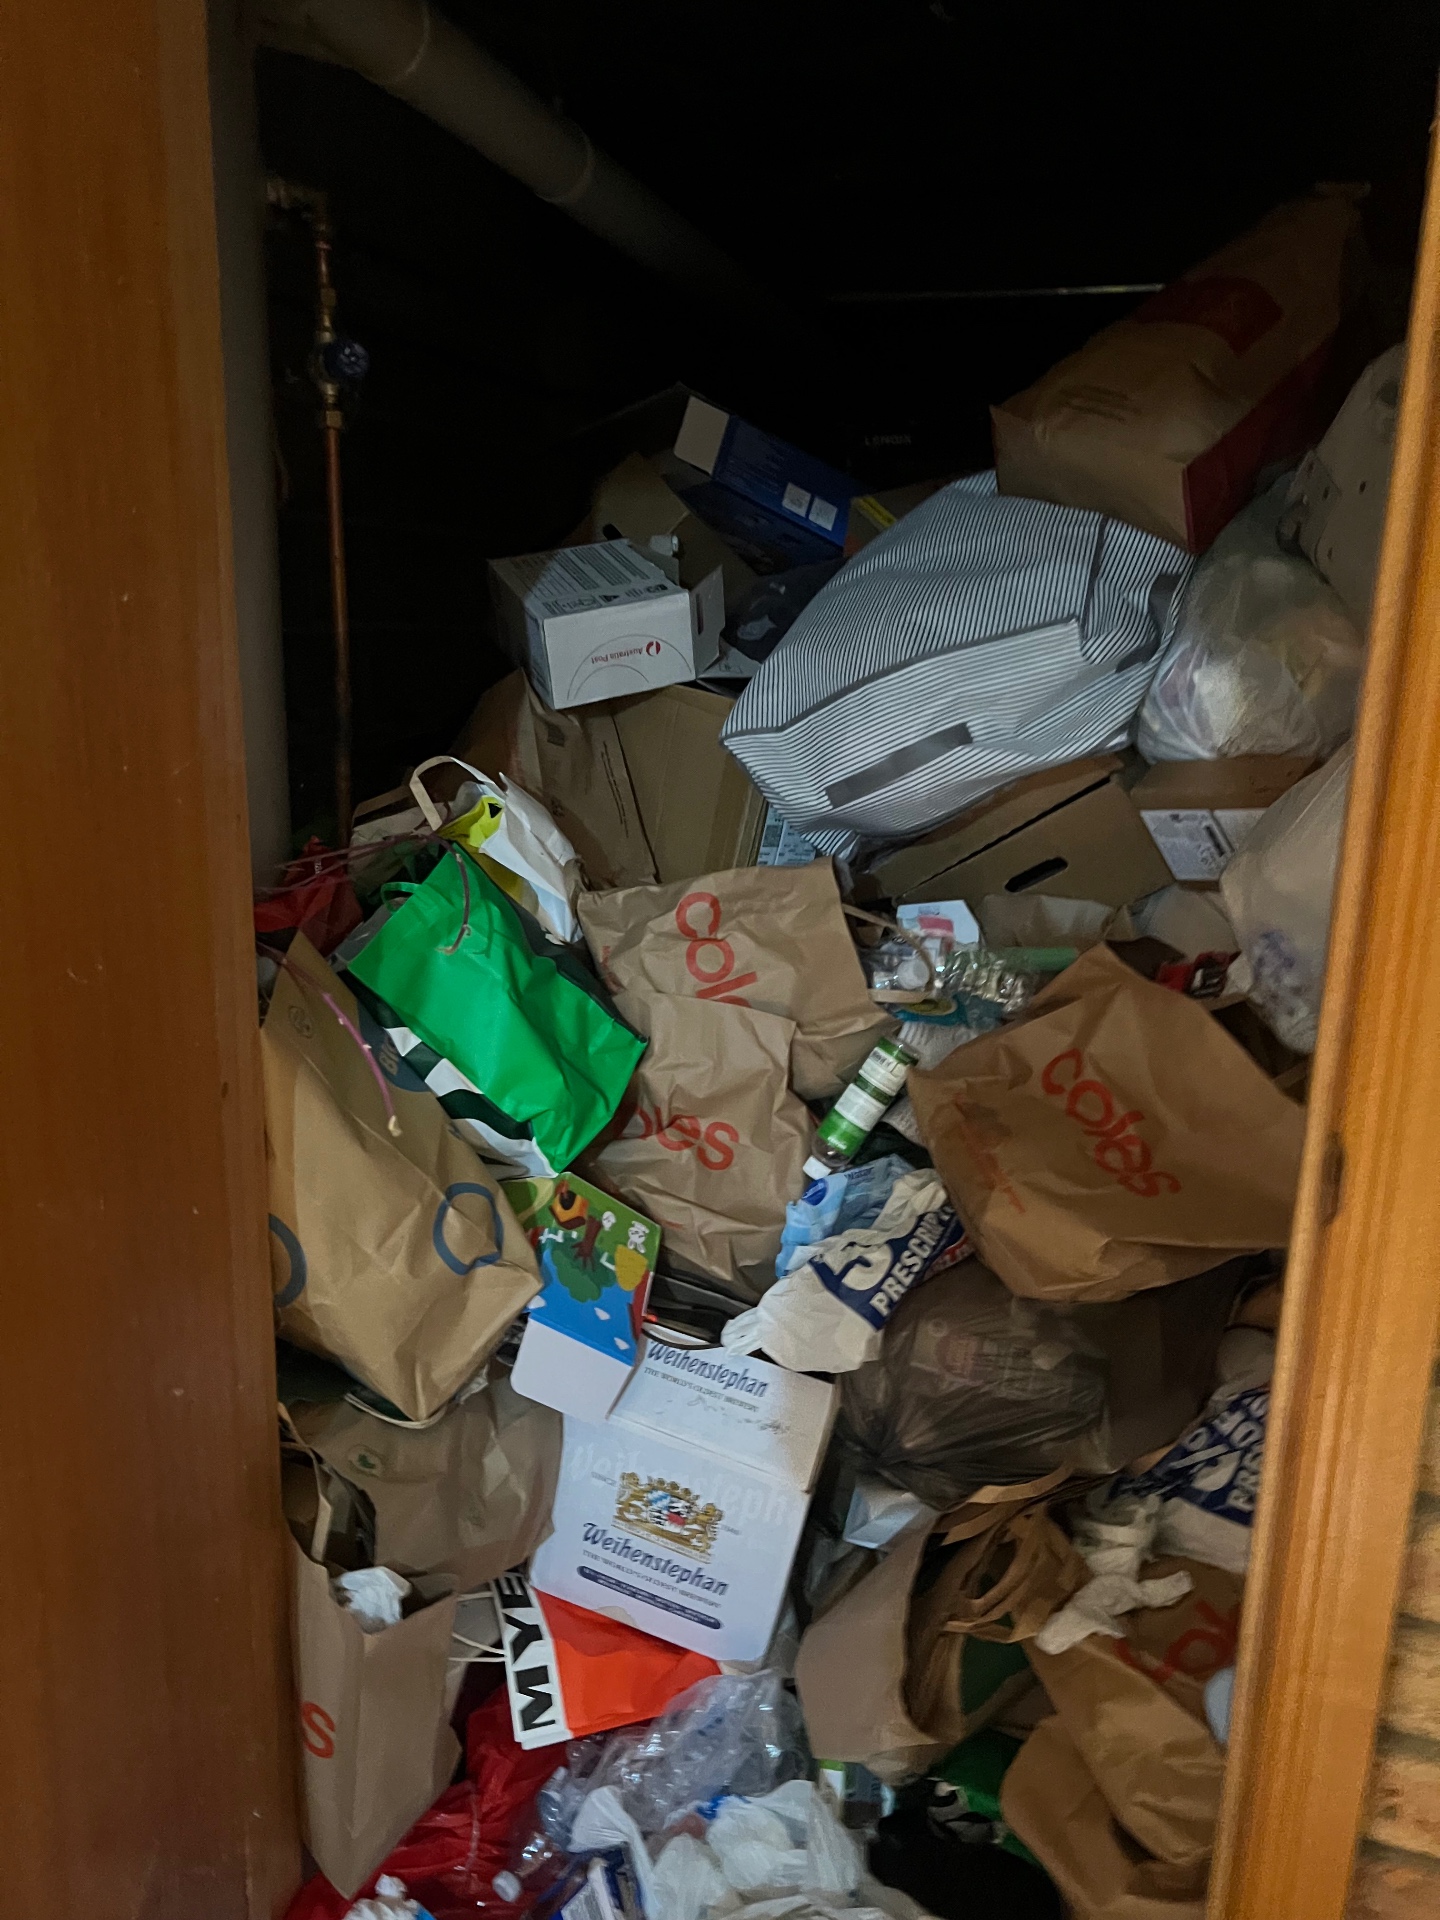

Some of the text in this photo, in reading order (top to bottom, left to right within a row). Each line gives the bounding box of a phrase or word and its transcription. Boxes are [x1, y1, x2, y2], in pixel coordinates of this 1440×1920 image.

[591, 647, 643, 664] Australia Post
[676, 891, 757, 1008] col
[647, 1340, 769, 1398] Weihenstephan
[582, 1522, 729, 1596] Weihenstephan
[495, 1576, 557, 1731] MYE
